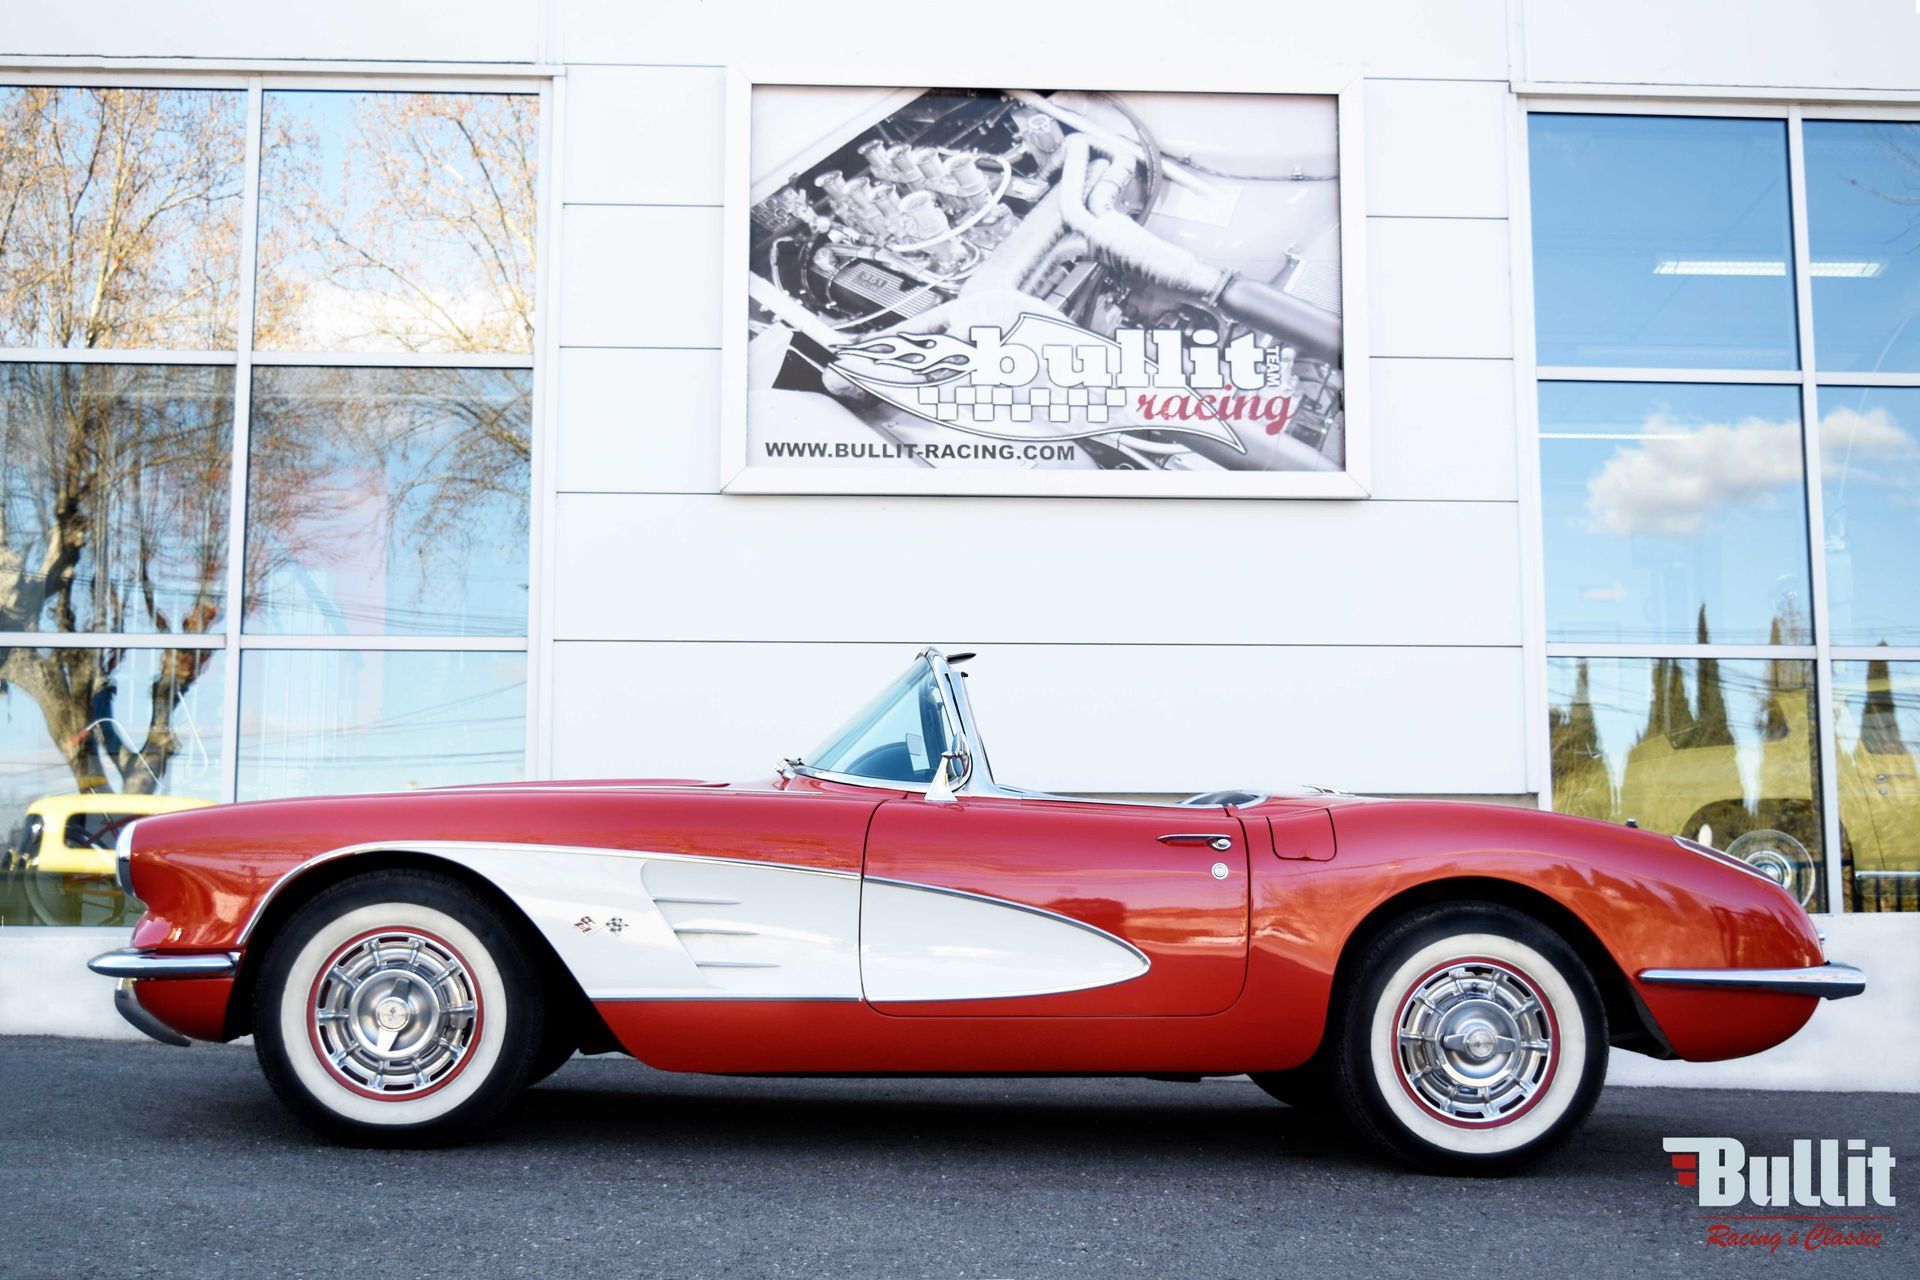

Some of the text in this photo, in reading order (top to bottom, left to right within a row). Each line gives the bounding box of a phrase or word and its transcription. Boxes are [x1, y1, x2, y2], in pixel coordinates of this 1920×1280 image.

[970, 326, 1265, 389] bullit
[1266, 345, 1280, 387] TEAM
[1136, 384, 1297, 436] racing
[765, 442, 1075, 461] WWW.BULLIT-RACING.COM
